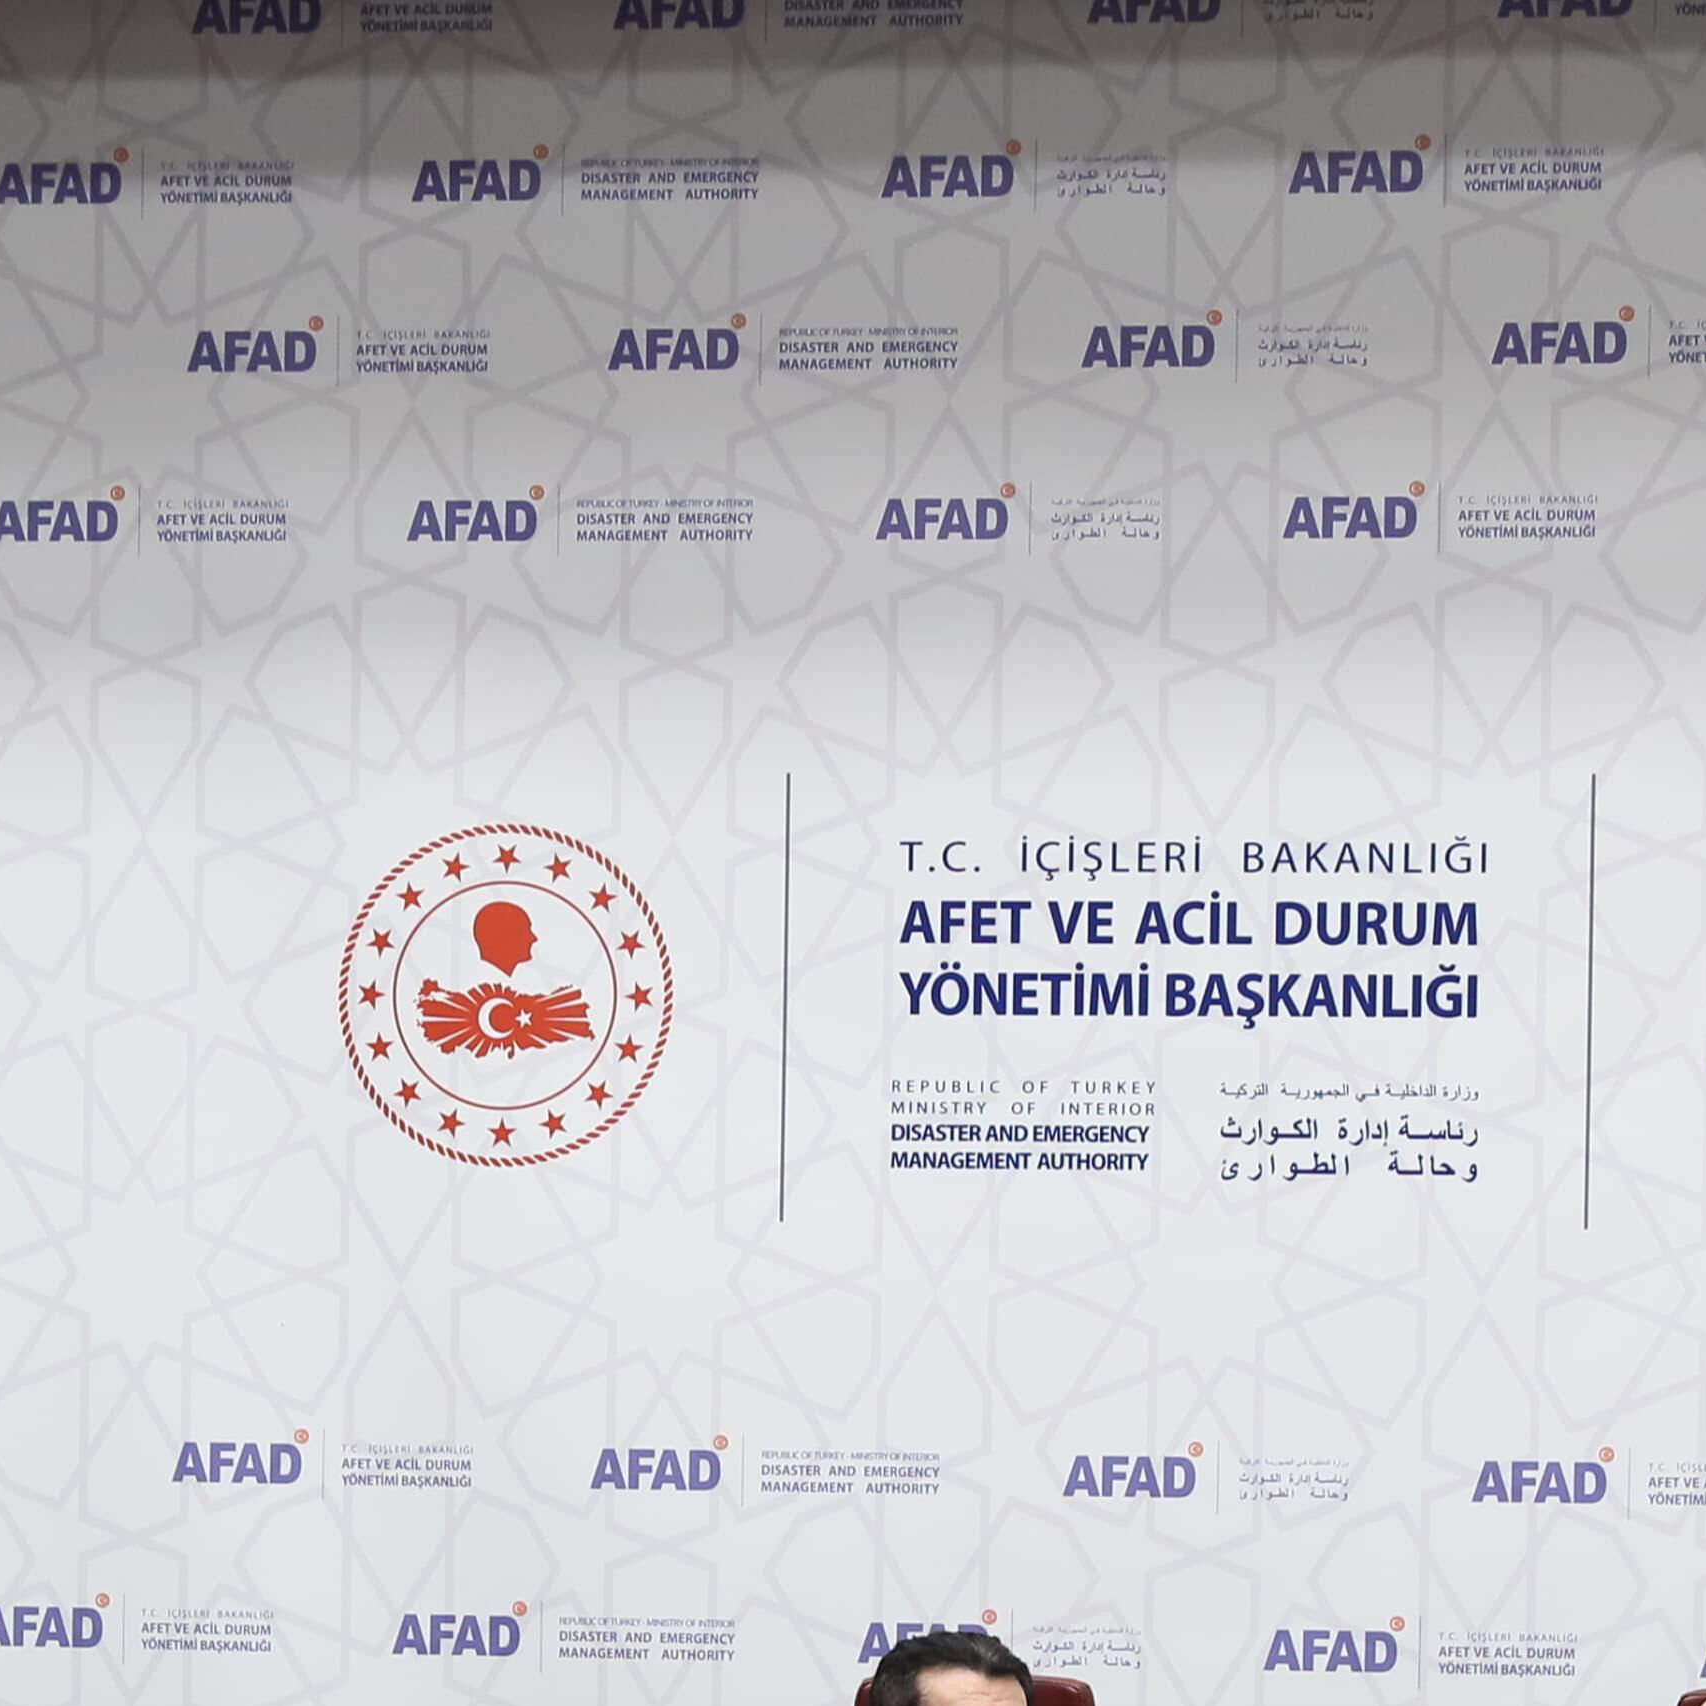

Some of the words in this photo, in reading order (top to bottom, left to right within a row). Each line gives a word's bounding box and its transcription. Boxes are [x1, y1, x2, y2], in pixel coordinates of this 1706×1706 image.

[192, 0, 321, 34] AFAD
[783, 14, 877, 27] MANAGEMENT
[888, 14, 964, 27] AUTHORITY
[410, 160, 540, 202] AFAD
[883, 154, 1015, 197] AFAD
[1288, 150, 1424, 193] AFAD
[186, 330, 317, 373] AFAD
[607, 328, 739, 371] AFAD
[1081, 325, 1215, 368] AFAD
[1488, 322, 1627, 365] AFAD
[1668, 333, 1701, 348] AFET
[406, 500, 536, 543] AFAD
[576, 512, 636, 526] DISASTER
[643, 512, 671, 525] AND
[677, 512, 754, 526] EMERGENCY
[576, 529, 668, 542] MANAGEMENT
[679, 528, 753, 542] AUTHORITY
[875, 498, 1009, 541] AFAD
[1281, 496, 1418, 540] AFAD
[1458, 509, 1490, 522] AFET
[1493, 509, 1510, 522] VE
[1514, 508, 1542, 522] ACİL
[1546, 508, 1596, 522] DURUM
[899, 840, 981, 873] T.C.
[1021, 835, 1201, 882] İÇİŞLERİ
[1243, 835, 1487, 874] BAKANLIĞI
[900, 899, 1032, 945] AFET
[1048, 900, 1114, 945] VE
[1135, 890, 1254, 945] ACİL
[1274, 900, 1478, 947] DURUM
[899, 961, 1150, 1017] YÖNETİMİ
[1165, 963, 1478, 1030] BAŞKANLIĞI
[891, 1080, 999, 1094] REPUBLIC
[1022, 1080, 1046, 1094] OF
[1071, 1080, 1156, 1094] TURKEY
[1442, 1083, 1480, 1102] وزارة
[891, 1101, 986, 1115] MINISTRY
[1011, 1102, 1035, 1115] OF
[1061, 1102, 1156, 1116] INTERIOR
[891, 1123, 982, 1142] DISASTER
[984, 1124, 1029, 1143] AND
[1032, 1125, 1150, 1144] EMERGENCY
[1220, 1116, 1318, 1146] الكوارث
[890, 1151, 1033, 1170] MANAGEMENT
[1036, 1152, 1150, 1171] AUTHORITY
[172, 1442, 301, 1484] AFAD
[590, 1448, 721, 1490] AFAD
[1062, 1456, 1196, 1498] AFAD
[1471, 1461, 1606, 1504] AFAD
[1648, 1476, 1680, 1489] AFET
[1683, 1476, 1700, 1489] VE
[391, 1615, 521, 1656] AFAD
[1263, 1629, 1398, 1672] AFAD
